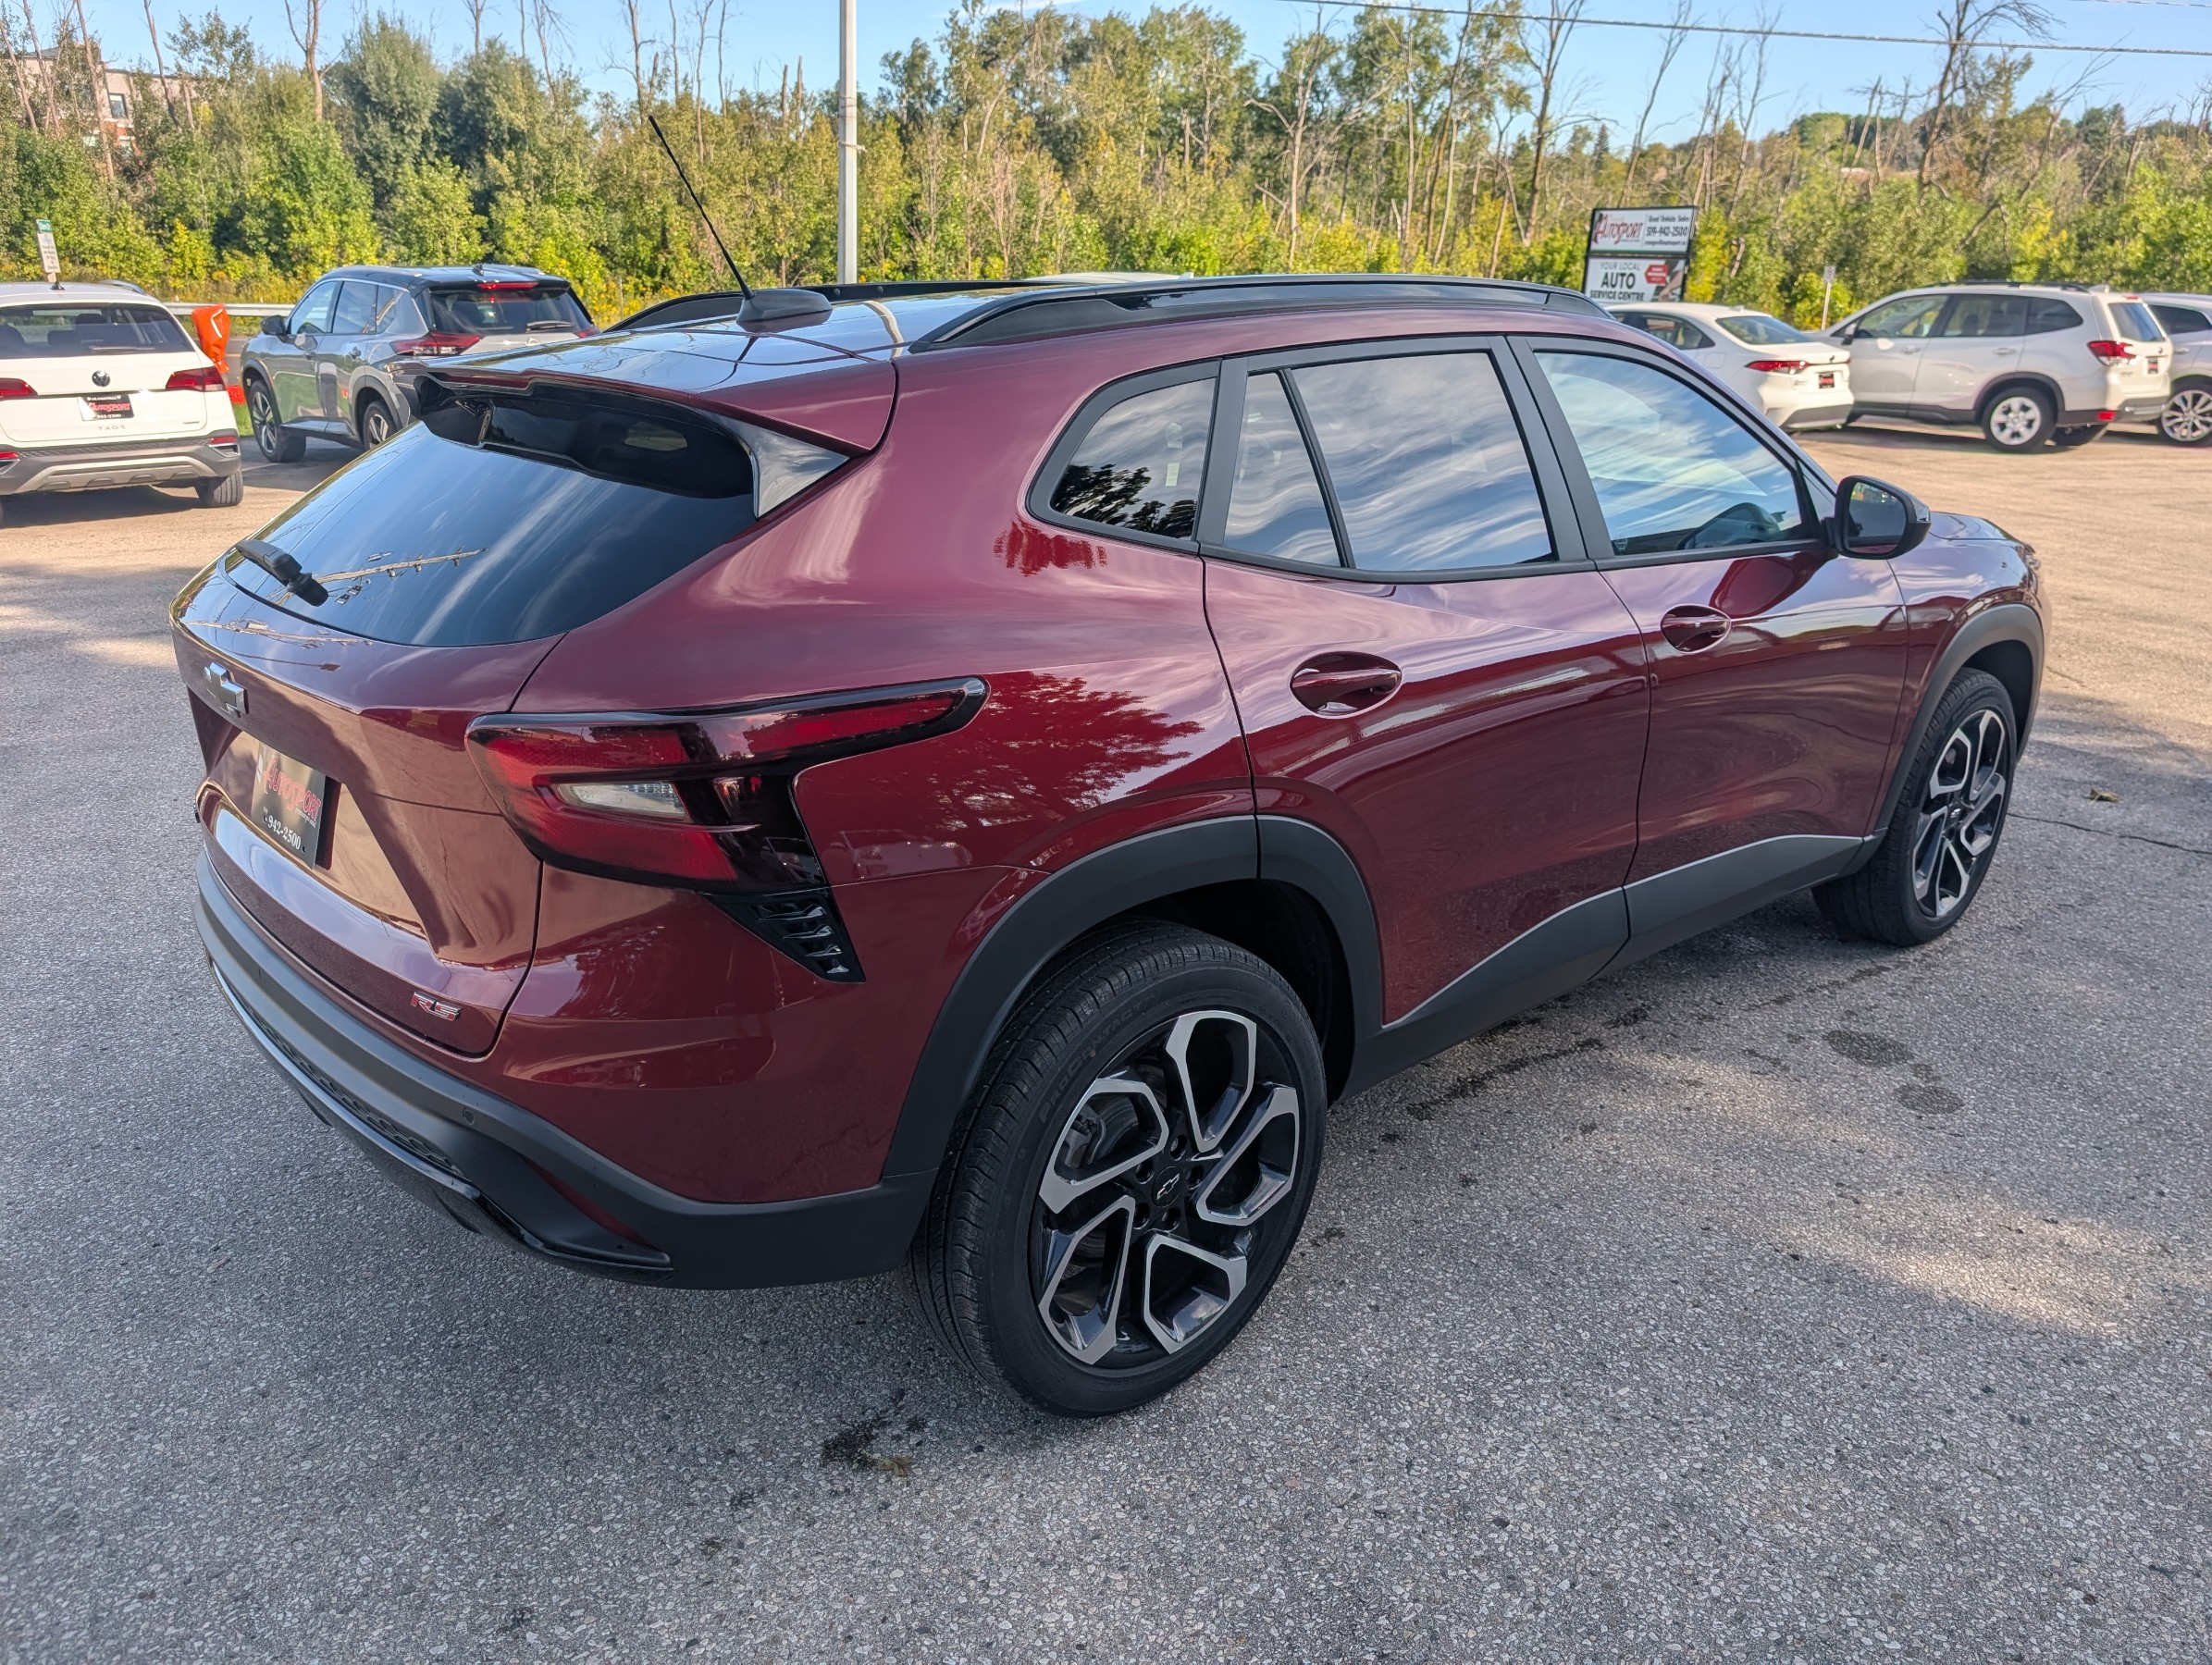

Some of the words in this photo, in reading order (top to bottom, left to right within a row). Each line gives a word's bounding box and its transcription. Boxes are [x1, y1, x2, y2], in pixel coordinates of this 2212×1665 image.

[1600, 261, 1618, 271] YOUR
[1619, 262, 1641, 271] LOCAL
[1600, 272, 1636, 290] AUTO
[1590, 290, 1617, 301] SERVICE
[1618, 290, 1645, 302] CENTRE
[267, 815, 302, 850] 942-2500
[411, 992, 461, 1021] RS
